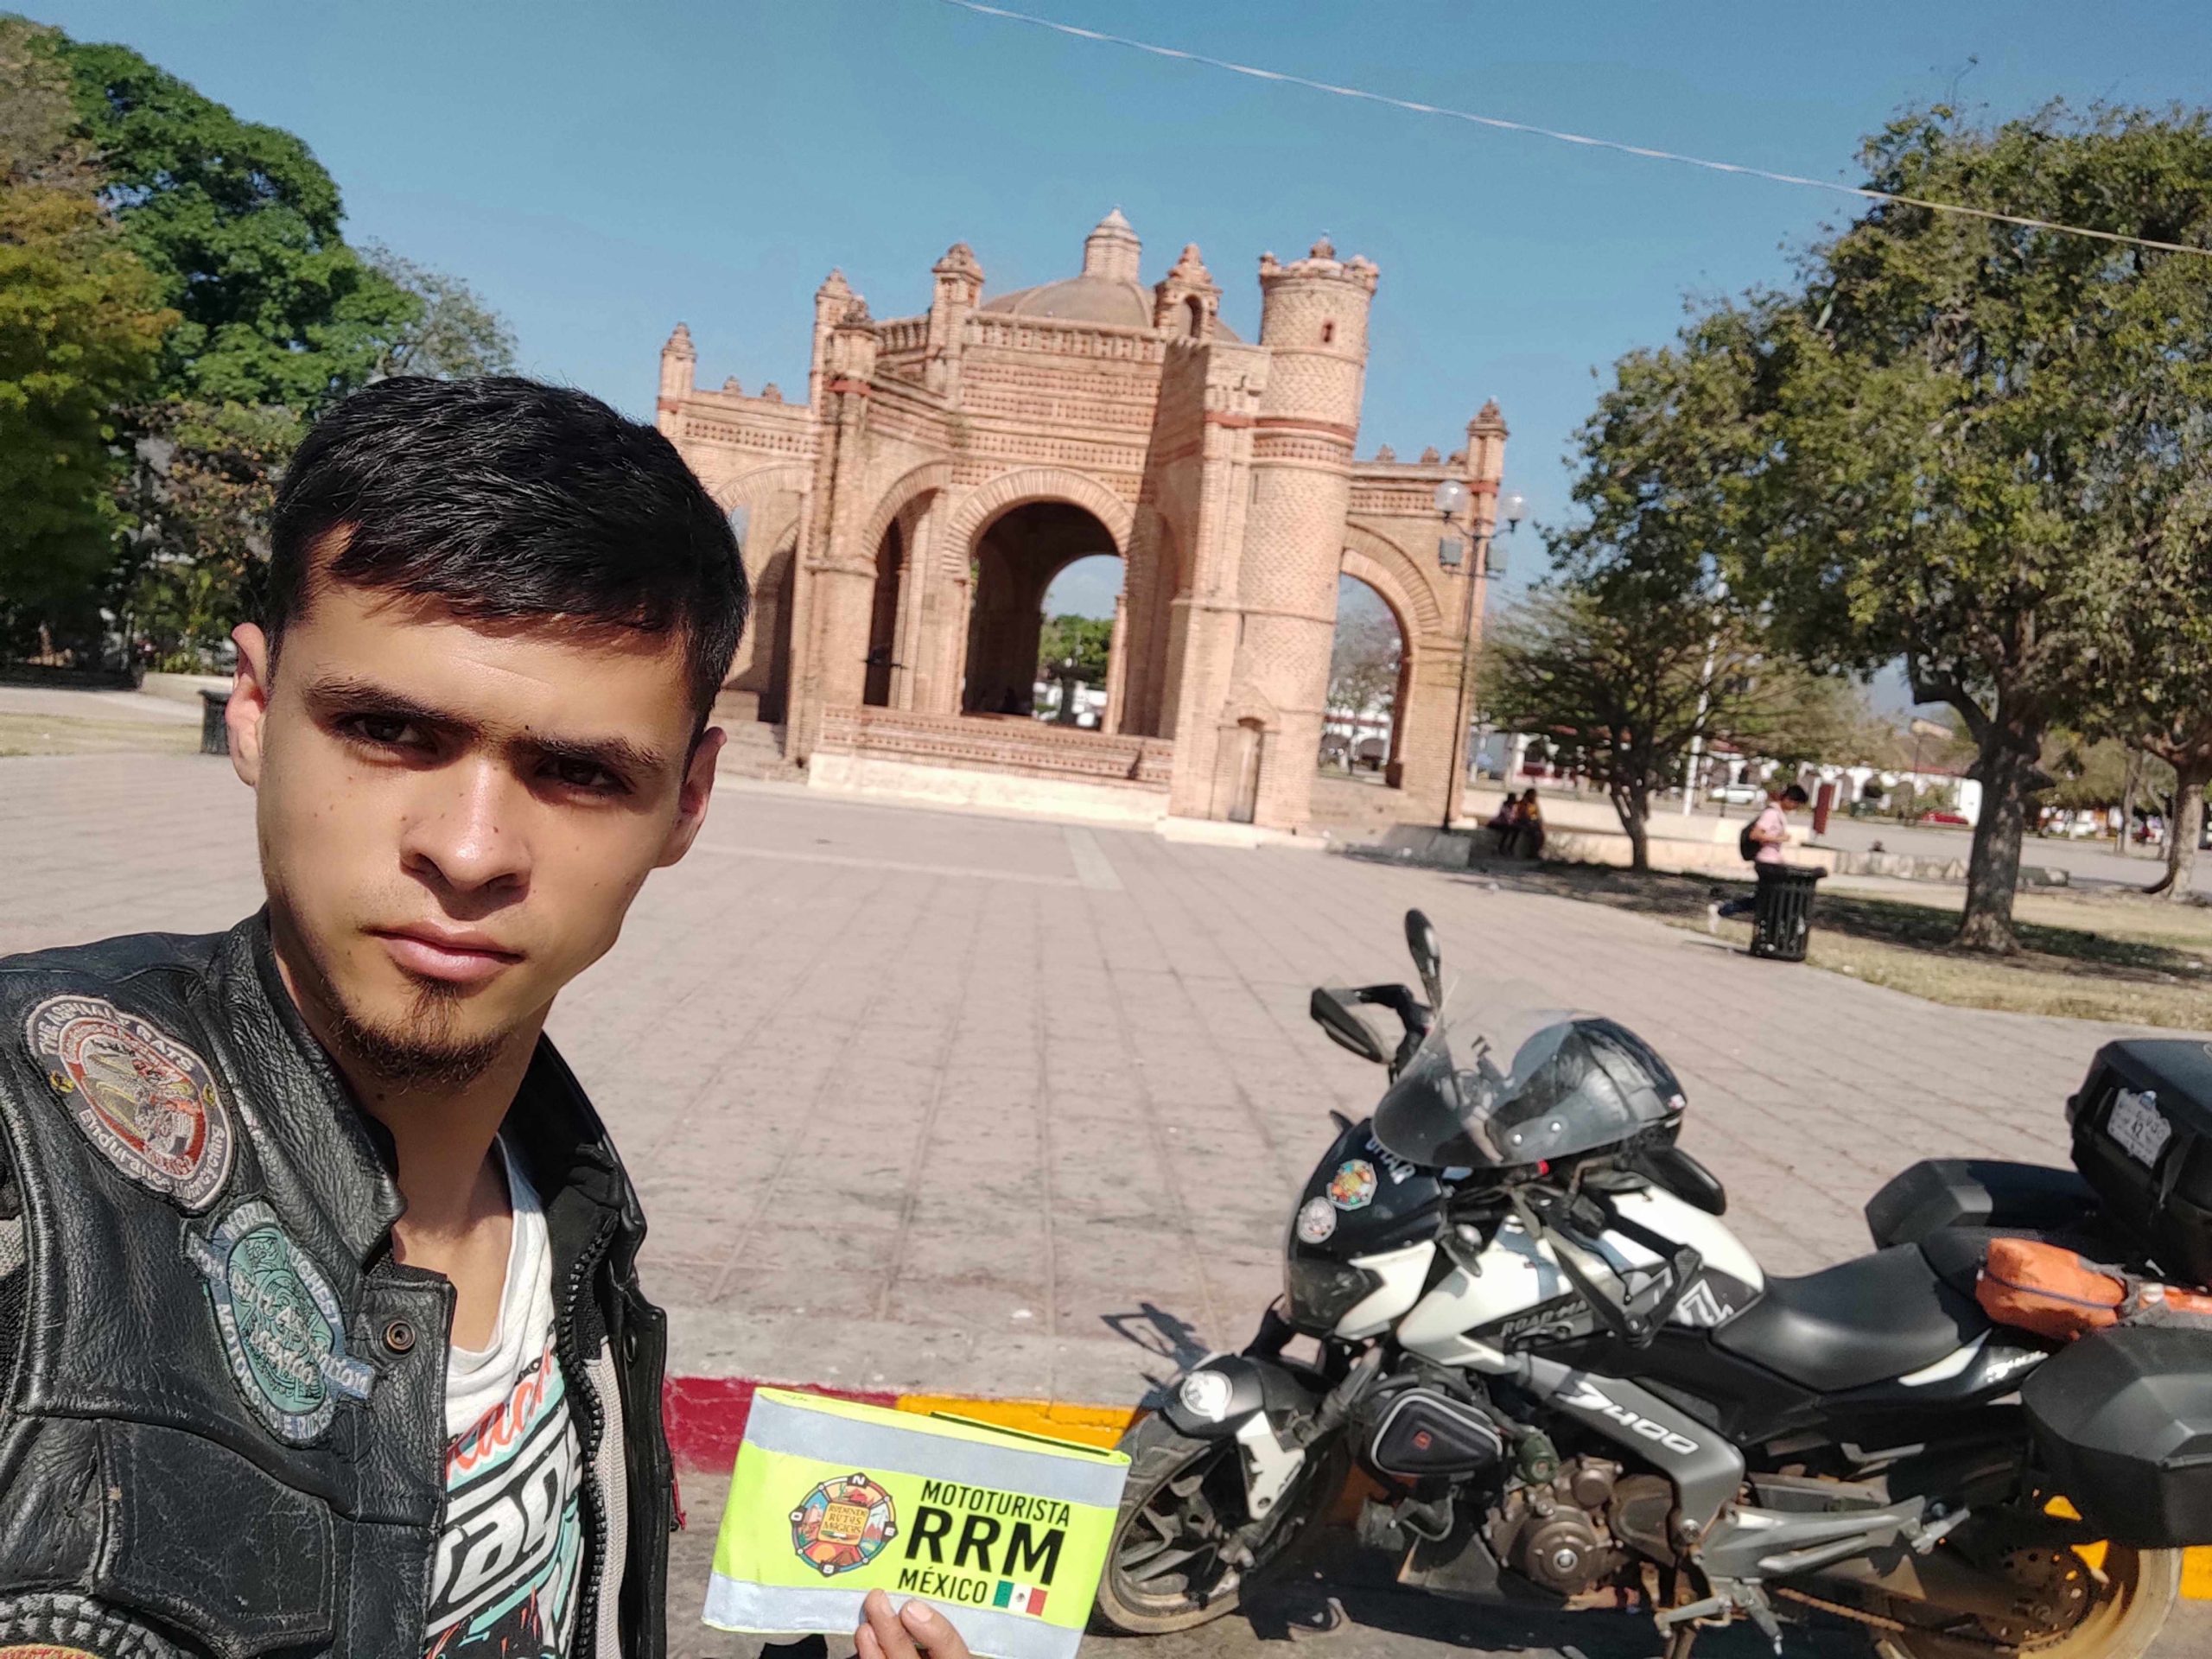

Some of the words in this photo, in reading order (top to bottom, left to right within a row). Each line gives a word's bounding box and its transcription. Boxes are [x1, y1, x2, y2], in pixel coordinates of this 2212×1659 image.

[919, 1479, 1071, 1528] MOTOTURISTA
[904, 1506, 1067, 1586] RRM
[898, 1565, 988, 1605] MÉXICO
